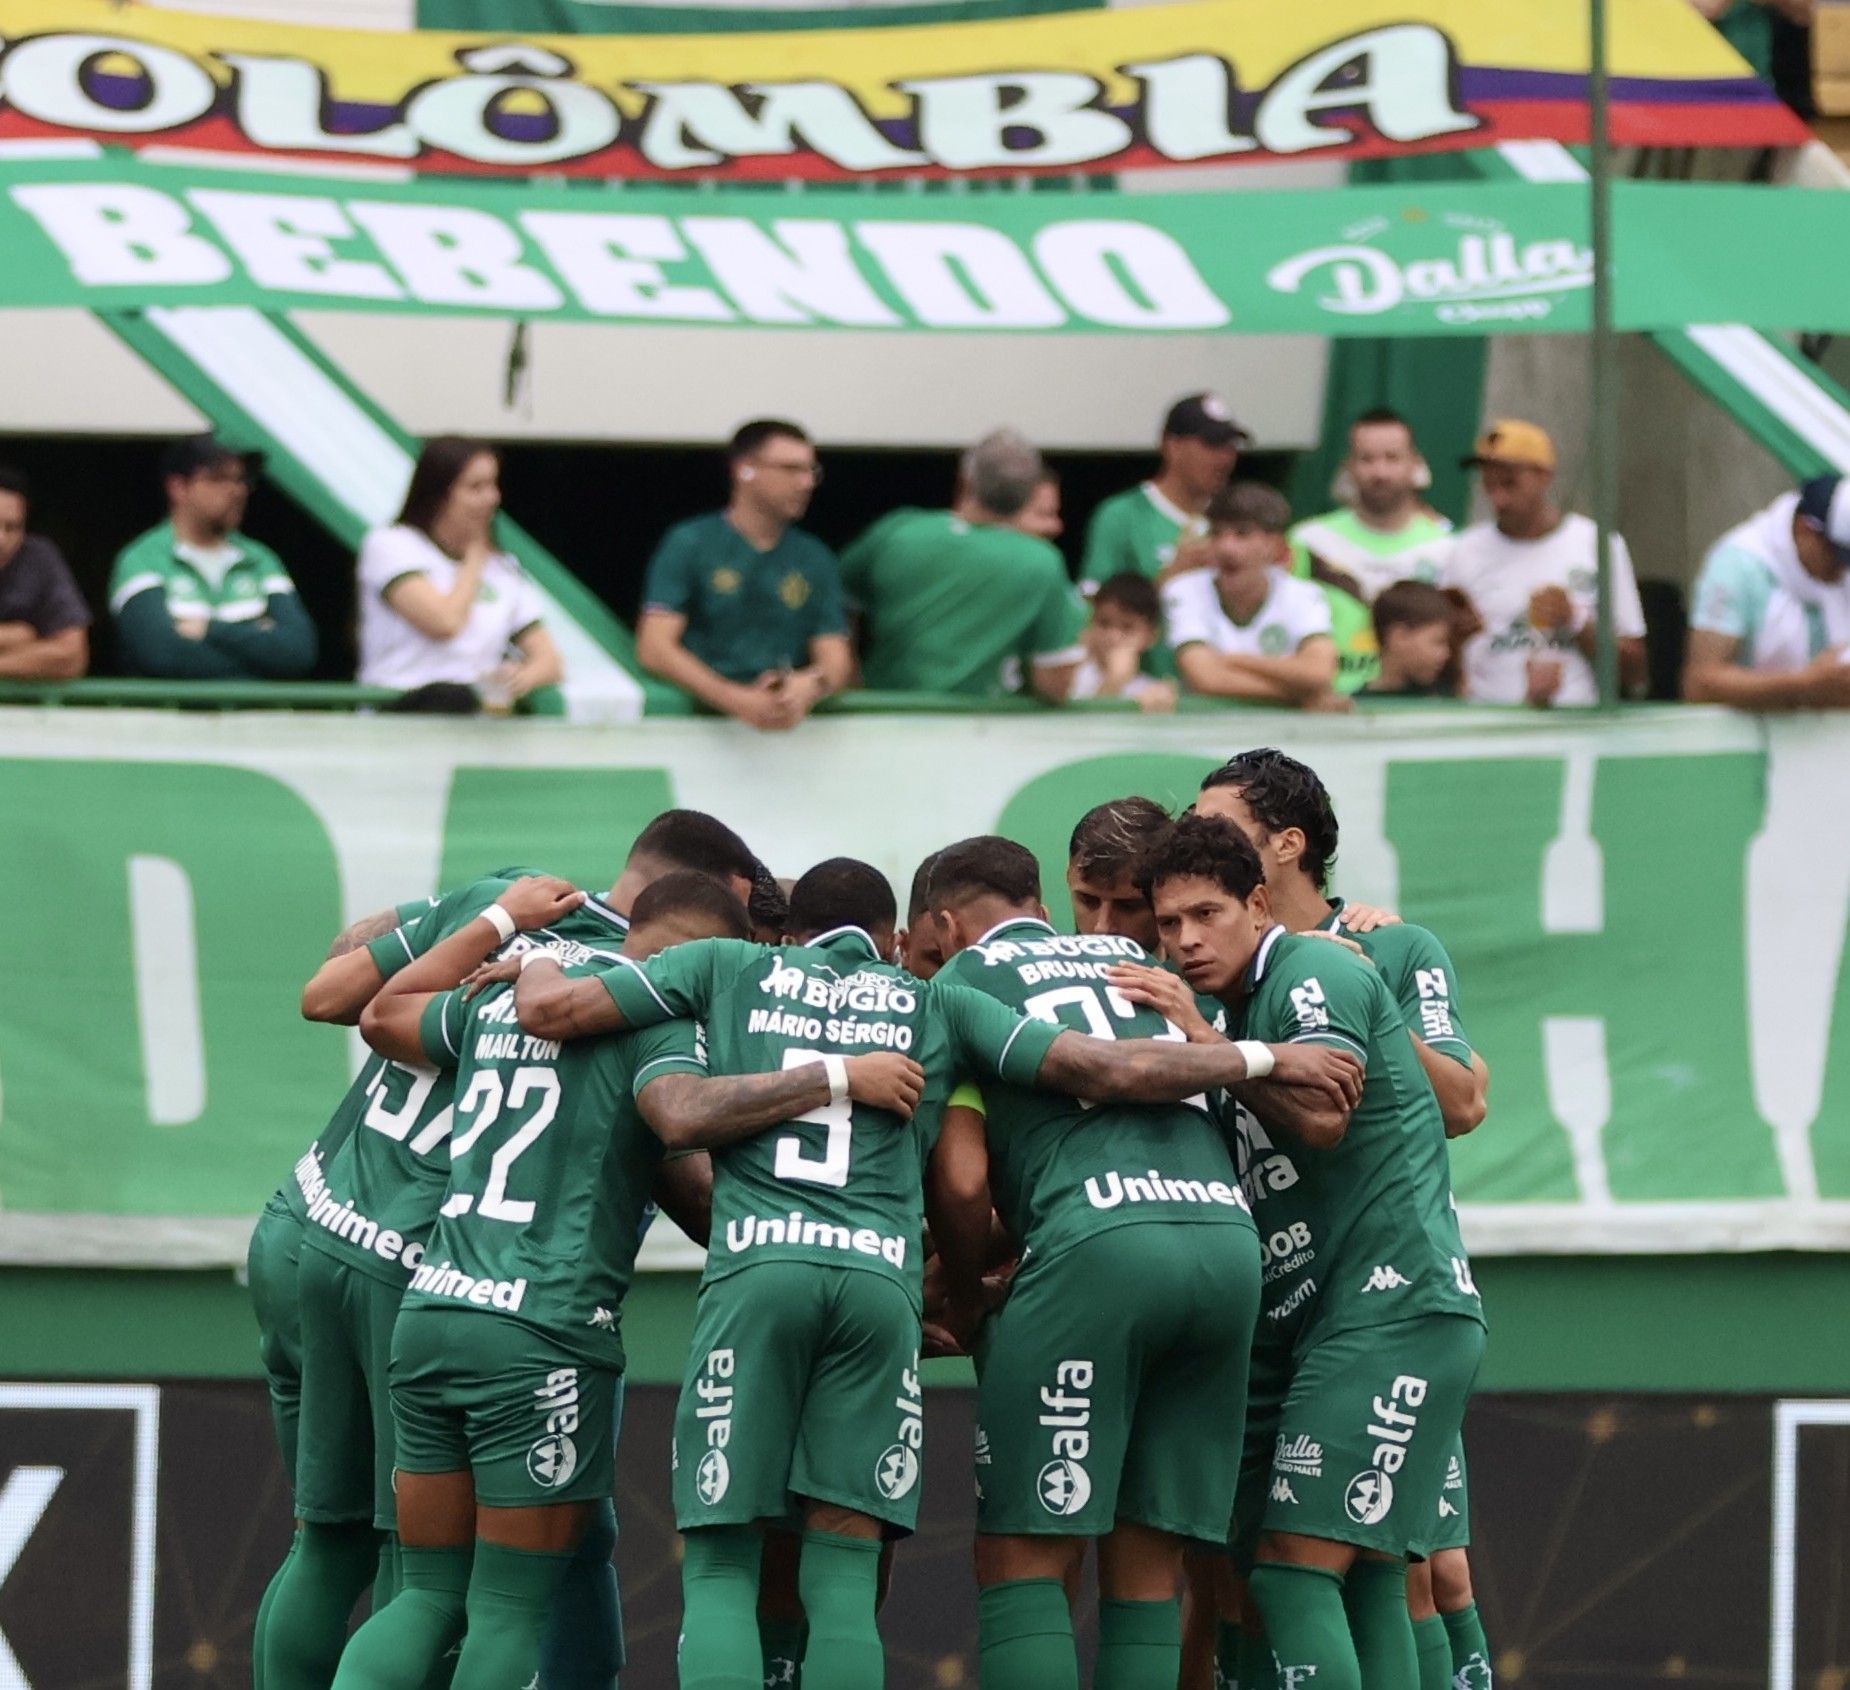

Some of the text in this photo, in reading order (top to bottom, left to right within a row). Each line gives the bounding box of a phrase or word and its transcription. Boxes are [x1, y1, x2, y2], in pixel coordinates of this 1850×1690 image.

[0, 22, 1480, 172] OLÔMBIA
[8, 182, 1230, 330] BEBENDO
[1266, 232, 1596, 315] Dalla
[747, 1005, 913, 1051] MÁRIO SÉRGIO
[802, 978, 917, 1015] BUGIO
[474, 1033, 562, 1061] MAILTON
[439, 1066, 561, 1224] 22
[408, 1260, 526, 1312] nimed
[726, 1211, 906, 1270] Unimed
[696, 1348, 735, 1449] alfa
[1039, 1360, 1094, 1460] alfa
[1366, 1374, 1429, 1475] alfa
